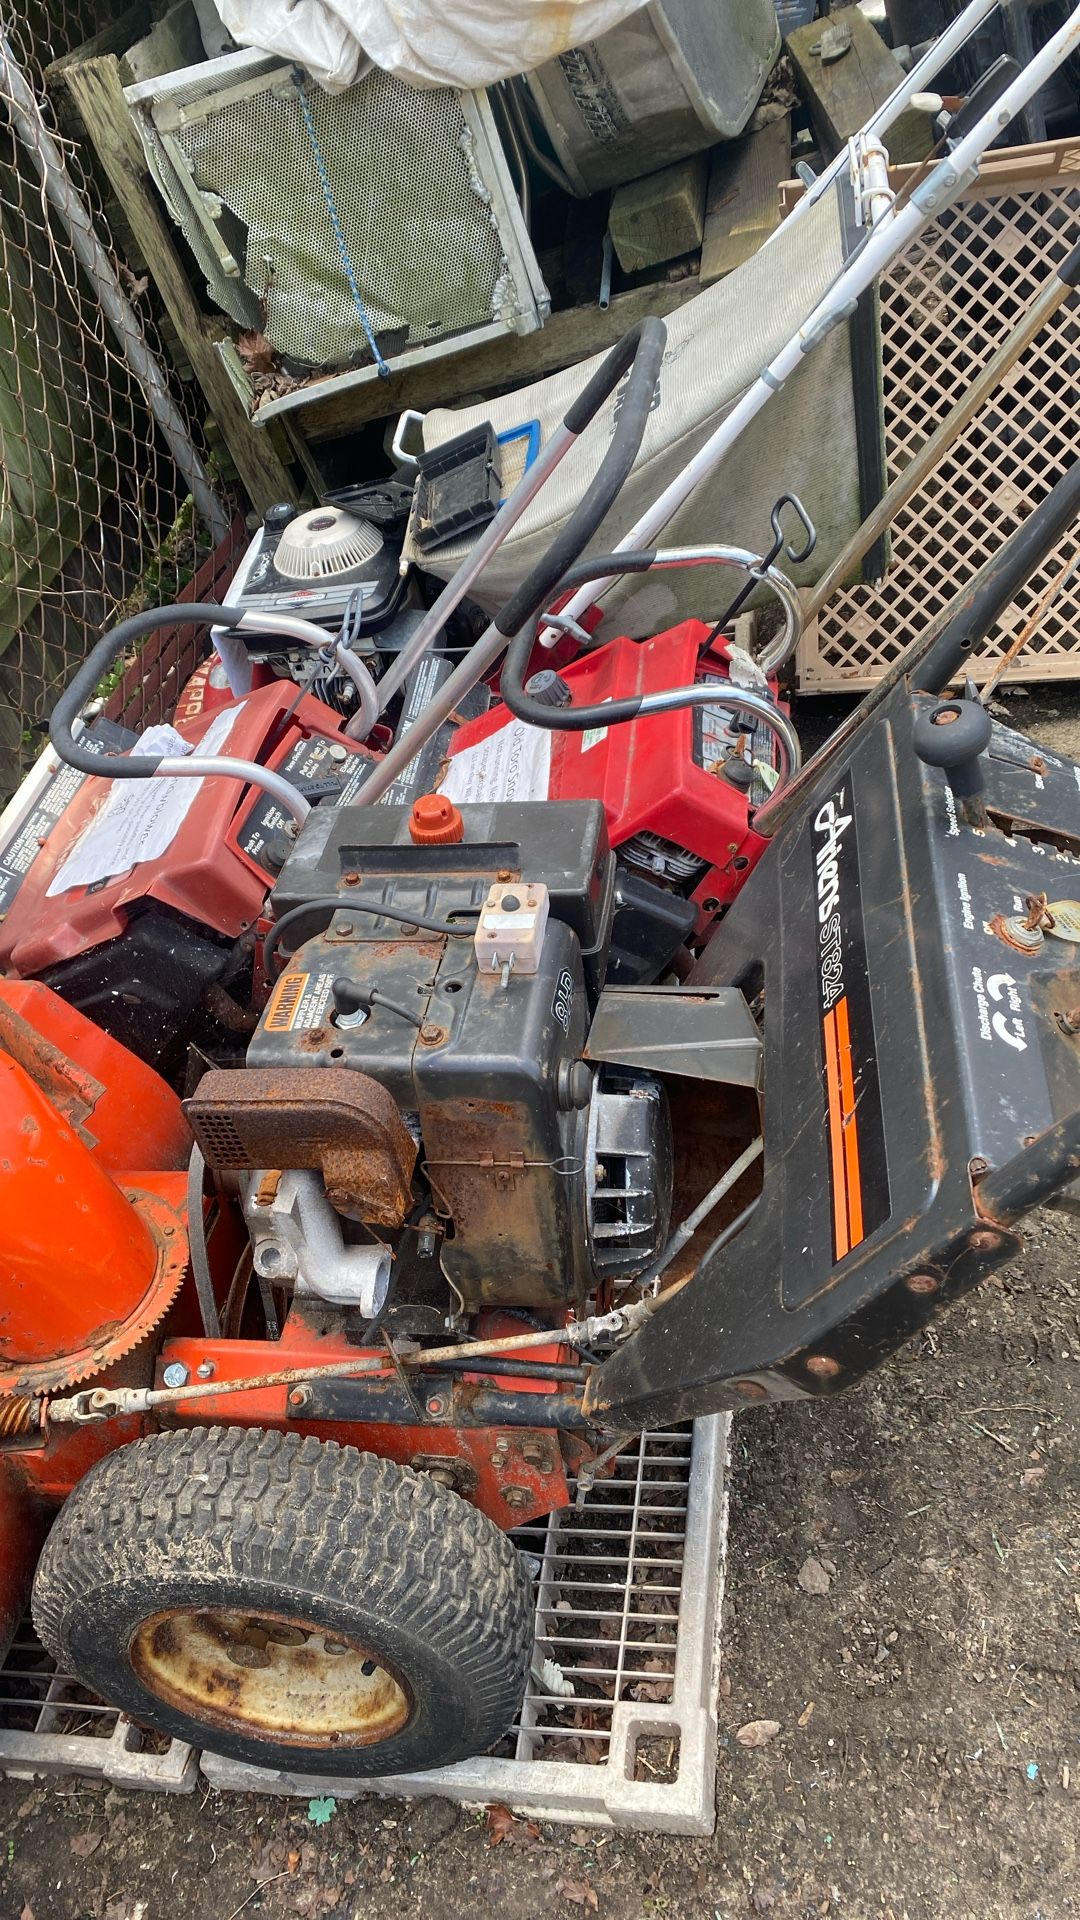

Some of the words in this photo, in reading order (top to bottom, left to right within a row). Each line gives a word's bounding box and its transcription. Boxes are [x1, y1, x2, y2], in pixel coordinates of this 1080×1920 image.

[513, 727, 527, 747] Old
[292, 742, 307, 762] Direction
[305, 758, 314, 767] To
[510, 745, 522, 773] Toro
[944, 785, 956, 813] Selector
[261, 806, 277, 827] Ignition
[266, 811, 282, 830] Switch
[276, 820, 285, 829] Off
[949, 812, 961, 836] Speed
[243, 837, 255, 854] Push
[251, 831, 261, 840] To
[972, 828, 986, 837] 5
[1004, 837, 1018, 847] 4
[3, 838, 23, 866] CAUTION
[252, 839, 265, 855] Prime
[1032, 846, 1046, 855] 3
[1056, 853, 1070, 864] 2
[814, 800, 853, 924] Ariens
[957, 872, 972, 902] Ignition
[963, 901, 975, 930] Engine
[1013, 896, 1024, 912] Run
[819, 912, 844, 1009] ST824
[971, 966, 987, 994] Chute
[268, 977, 304, 1028] WARNING
[302, 995, 319, 1029] ADJACENT
[314, 973, 327, 996] AREAS
[310, 1014, 321, 1029] MAY
[316, 988, 330, 1015] EXCEED
[1006, 986, 1022, 1012] Right
[293, 1000, 311, 1029] MUFFLER
[977, 994, 993, 1041] Discharge
[1012, 1017, 1026, 1038] Left
